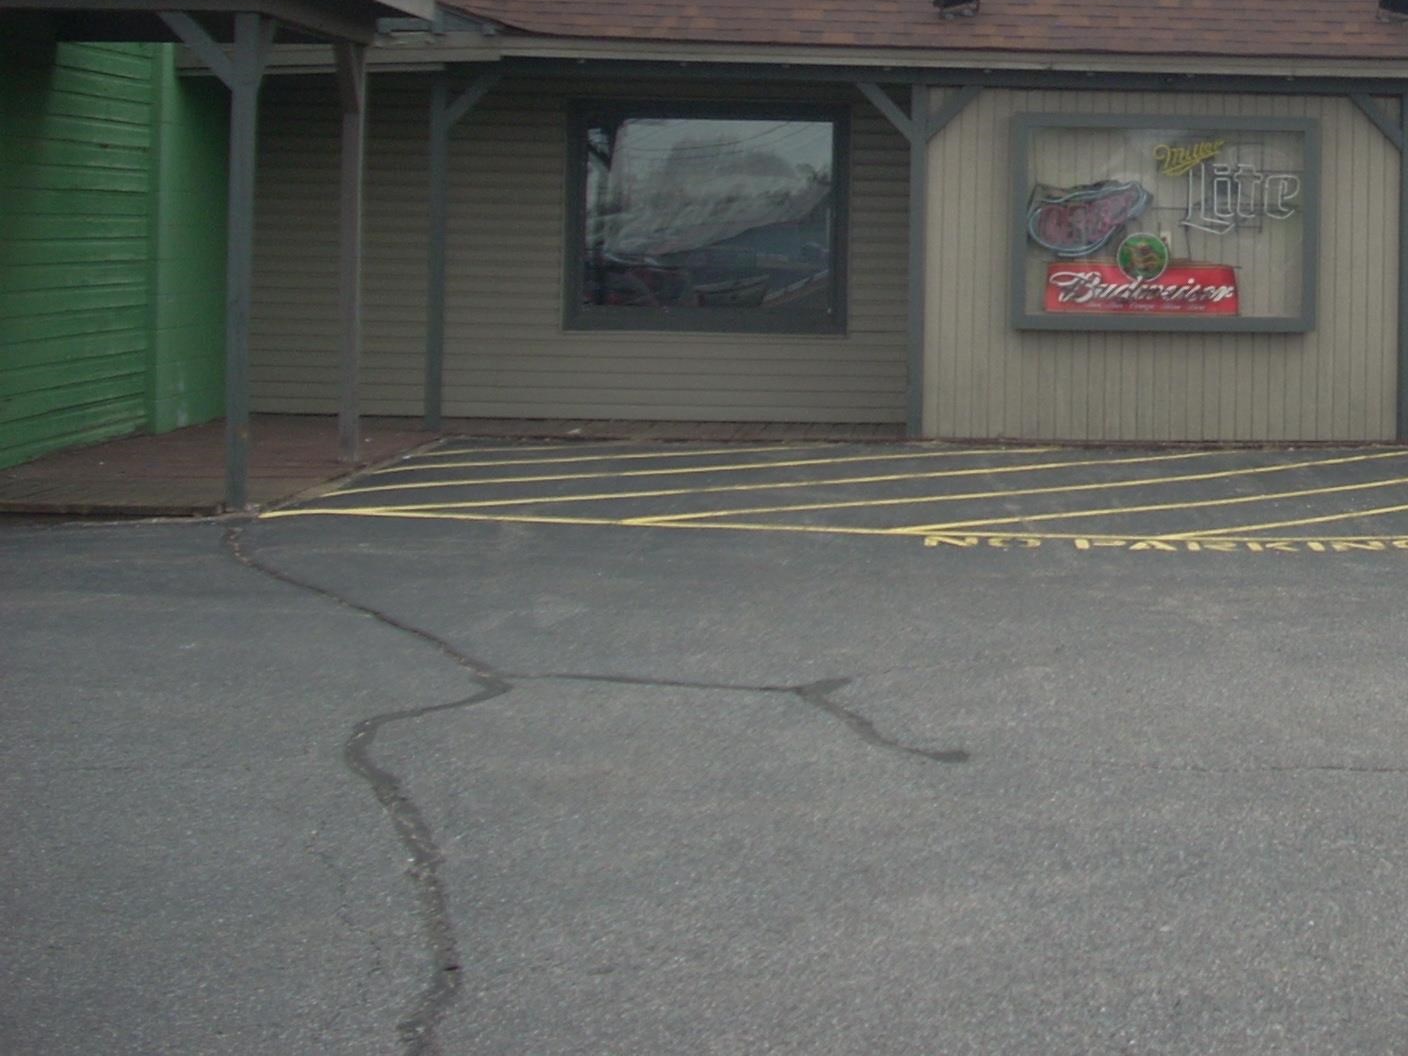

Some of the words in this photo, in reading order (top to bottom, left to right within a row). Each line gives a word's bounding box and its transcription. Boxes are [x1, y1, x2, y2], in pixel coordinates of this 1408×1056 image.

[1181, 162, 1300, 234] Lite
[1049, 271, 1235, 303] Budweiser
[923, 536, 1041, 547] NO
